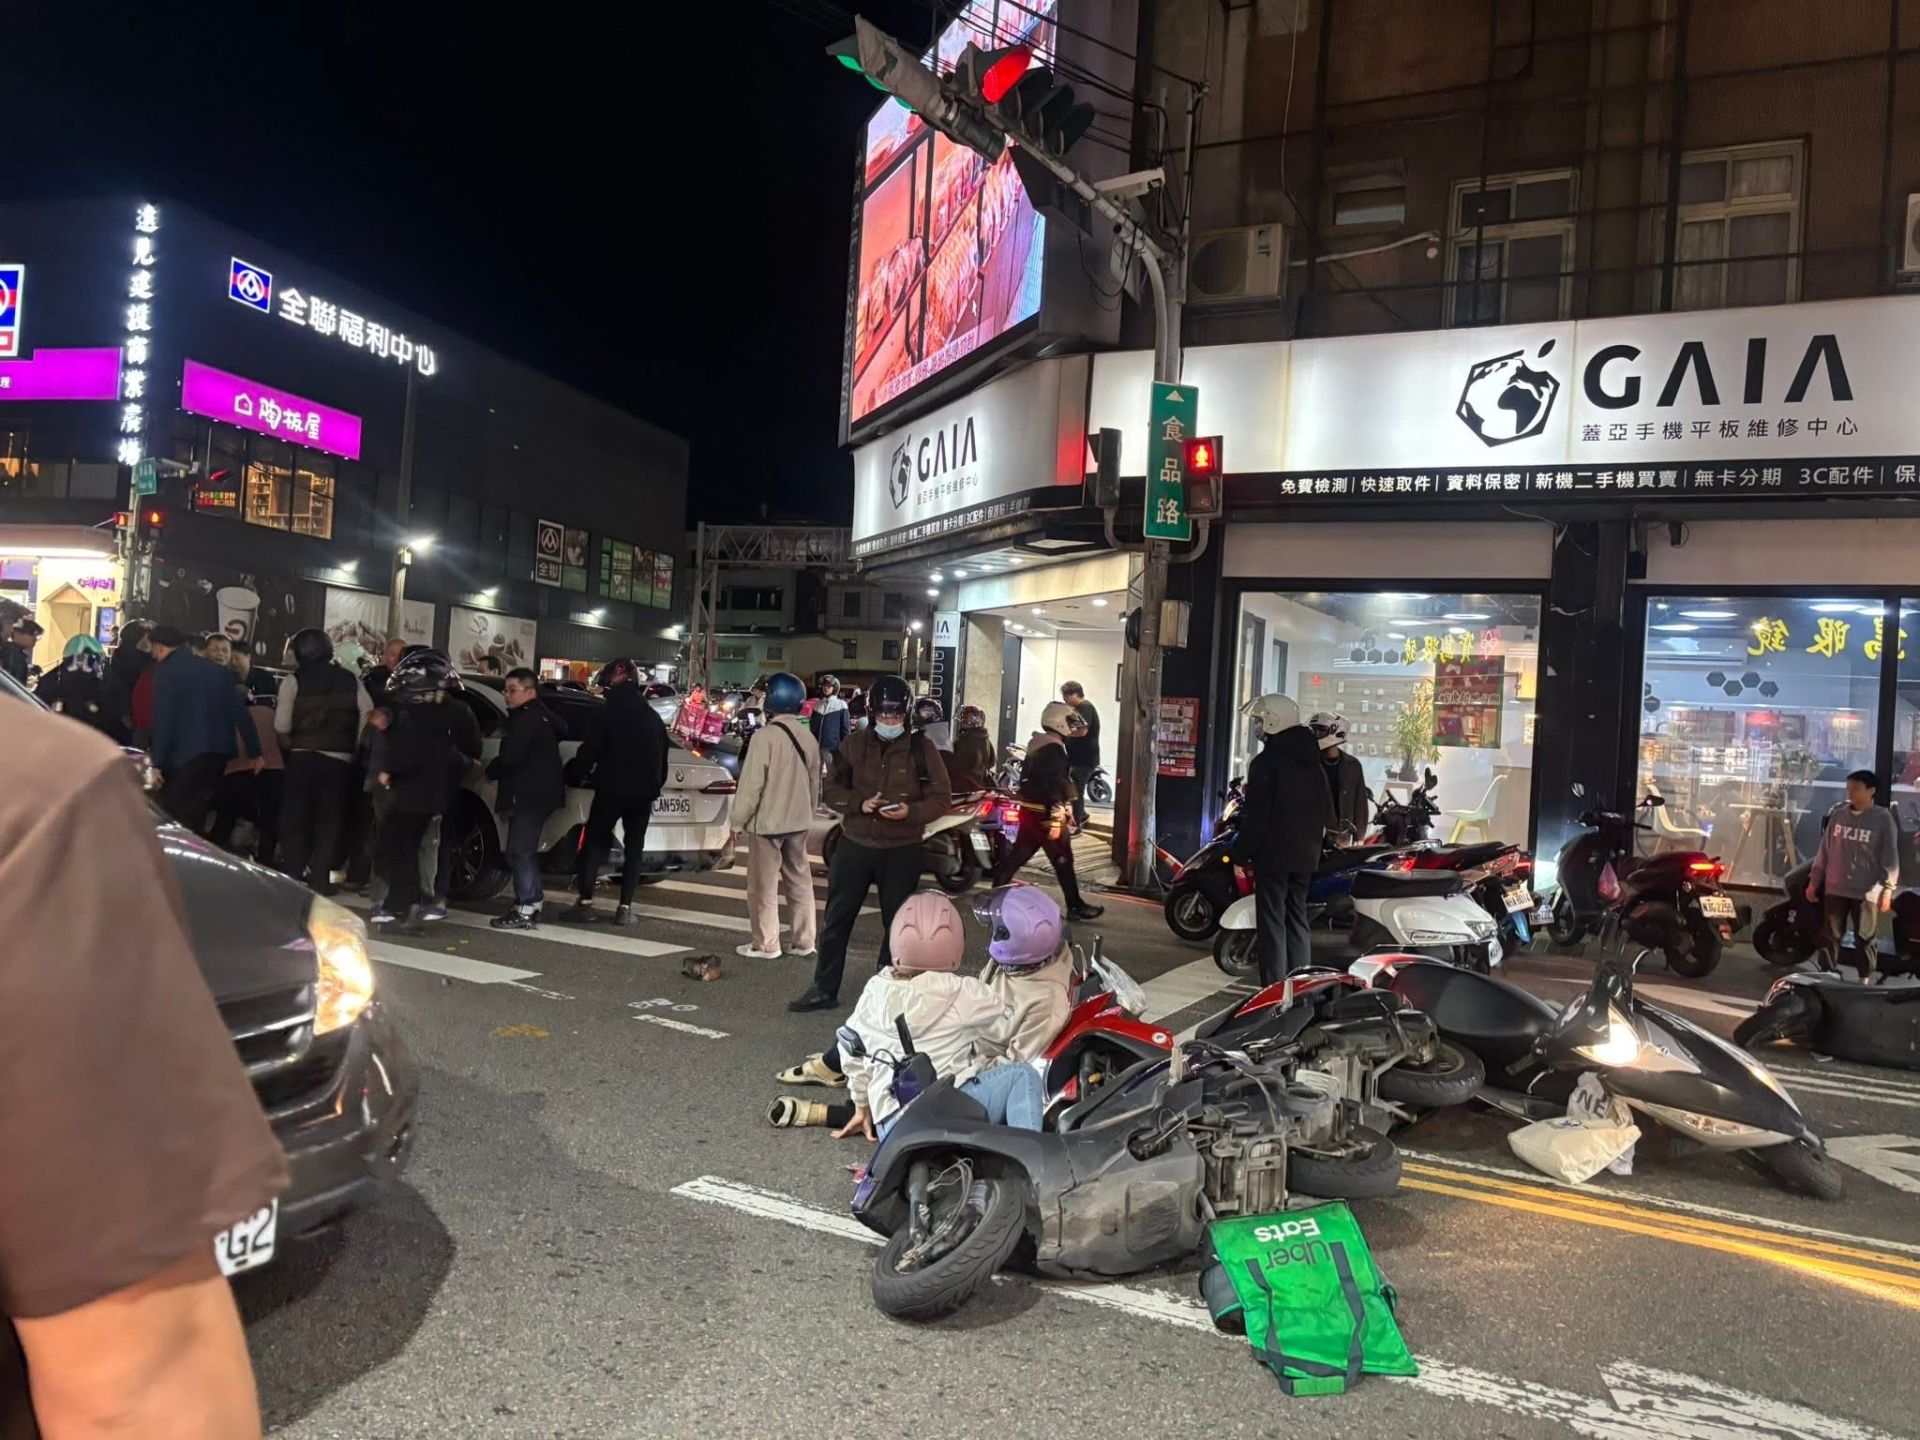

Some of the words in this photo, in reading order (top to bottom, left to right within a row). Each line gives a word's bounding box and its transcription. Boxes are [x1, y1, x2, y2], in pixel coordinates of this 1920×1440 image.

[278, 288, 435, 376] 全聯福利中心
[1583, 334, 1854, 409] GAIA
[258, 396, 321, 440] 陶板屋
[1581, 416, 1859, 443] 蓋亞手機平板維修中心
[917, 416, 977, 482] GAIA
[1156, 415, 1185, 525] 食品路
[1280, 476, 1348, 495] 免費檢測
[1360, 474, 1431, 493] 快速取件
[1446, 472, 1521, 492] 資料保密
[1535, 469, 1677, 489] 新機二手機買賣
[1694, 467, 1782, 488] 無卡分期
[1799, 465, 1875, 485] 3C配件
[1253, 1217, 1321, 1243] Eats
[1266, 1239, 1331, 1270] Uber
